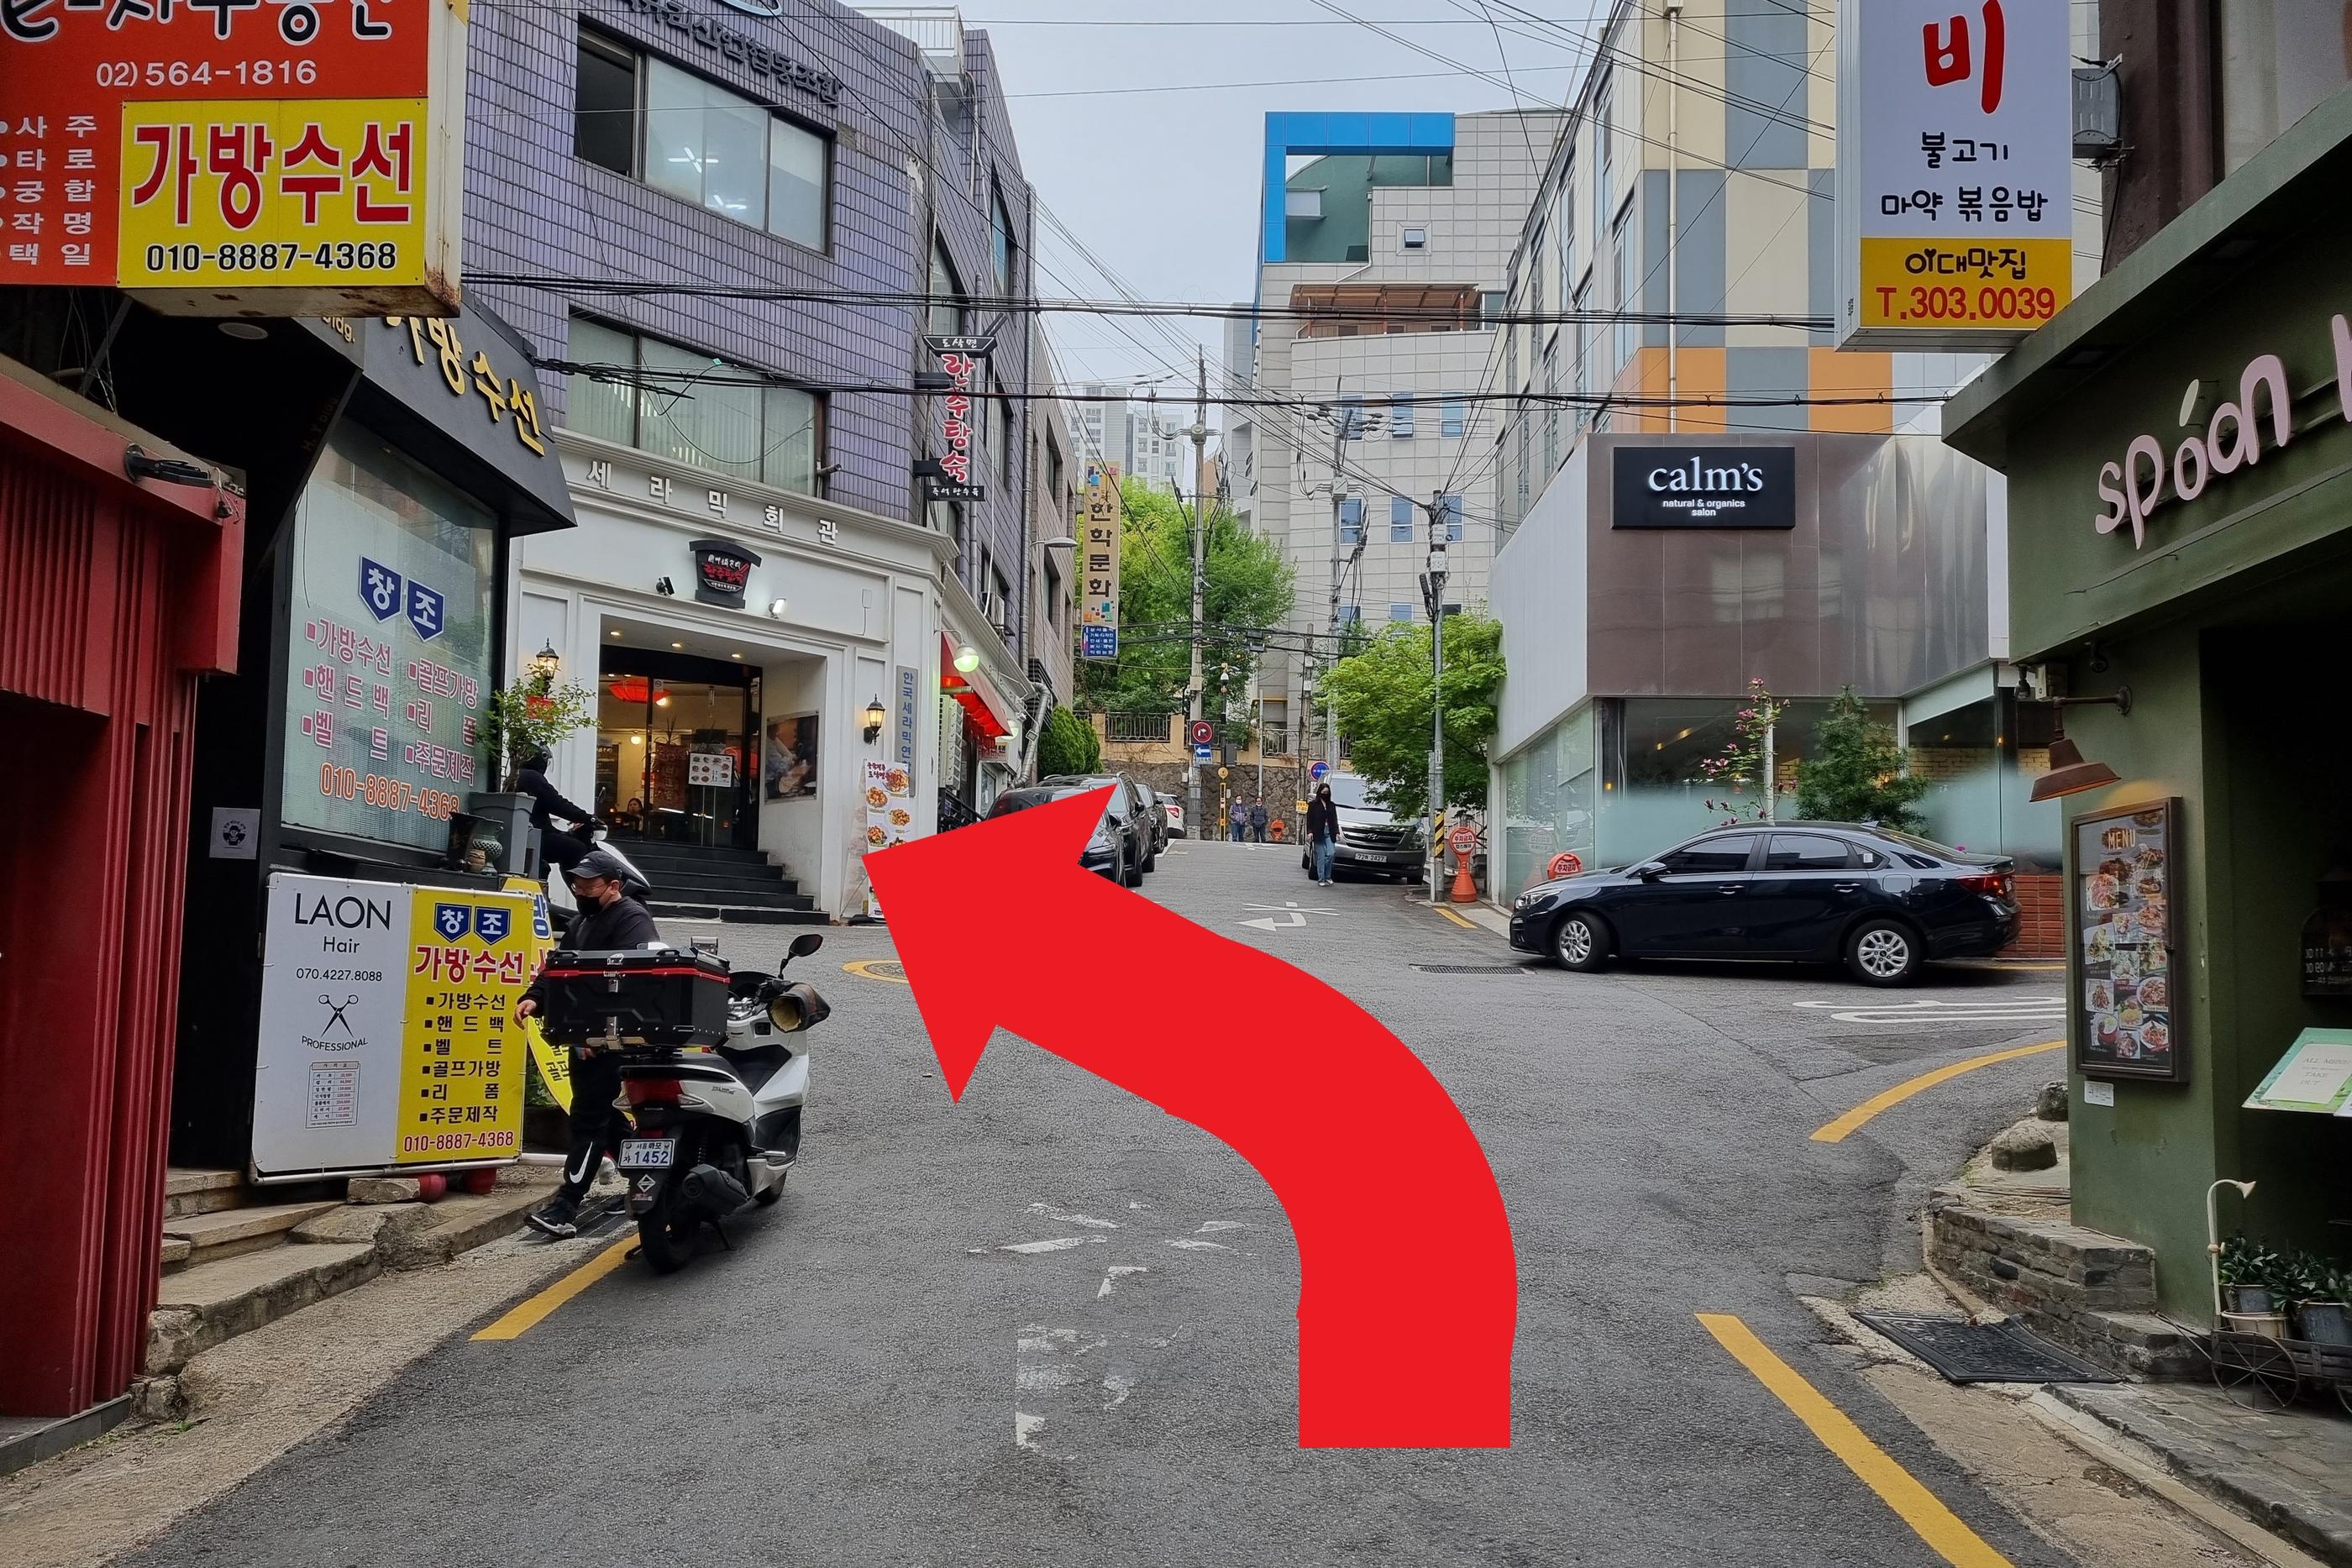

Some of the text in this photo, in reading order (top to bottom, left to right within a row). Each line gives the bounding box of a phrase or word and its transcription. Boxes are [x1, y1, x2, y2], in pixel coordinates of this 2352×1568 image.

[1923, 0, 2005, 114] 비
[1921, 132, 2008, 168] 불고기
[131, 122, 412, 230] 가방수선
[1882, 186, 2048, 222] 마약 볶음밥
[144, 241, 396, 272] 010-8887-4368
[1905, 249, 2026, 280] 이대맛집
[1876, 286, 2055, 321] T.303.0039
[942, 338, 978, 349] 도삭면
[1648, 456, 1763, 491] calm's
[586, 459, 838, 546] 세라믹회관
[1662, 499, 1746, 510] natural & organics
[1692, 508, 1716, 517] salon
[1089, 503, 1114, 597] 한학문화
[368, 568, 436, 630] 창조
[318, 618, 391, 676] 가방수선
[315, 664, 390, 720] 핸드백
[418, 658, 478, 709] 골프가방
[415, 740, 475, 786] 주문제작
[320, 762, 459, 821] 010-8887-4368
[2108, 828, 2136, 850] MENU
[1557, 863, 1577, 872] 주차금지
[294, 893, 391, 931] LAON
[441, 908, 502, 936] 창조
[323, 936, 360, 954] Hair
[296, 968, 382, 982] 070.4227.8088
[415, 946, 526, 985] 가방수선
[438, 992, 506, 1010] 가방수선
[437, 1015, 504, 1033] 핸드백
[302, 1035, 369, 1051] PROFESSIONAL
[433, 1061, 501, 1078] 골프가방
[430, 1105, 498, 1125] 주문제작
[403, 1130, 514, 1152] 010-8887-4368
[634, 1151, 669, 1164] 1452
